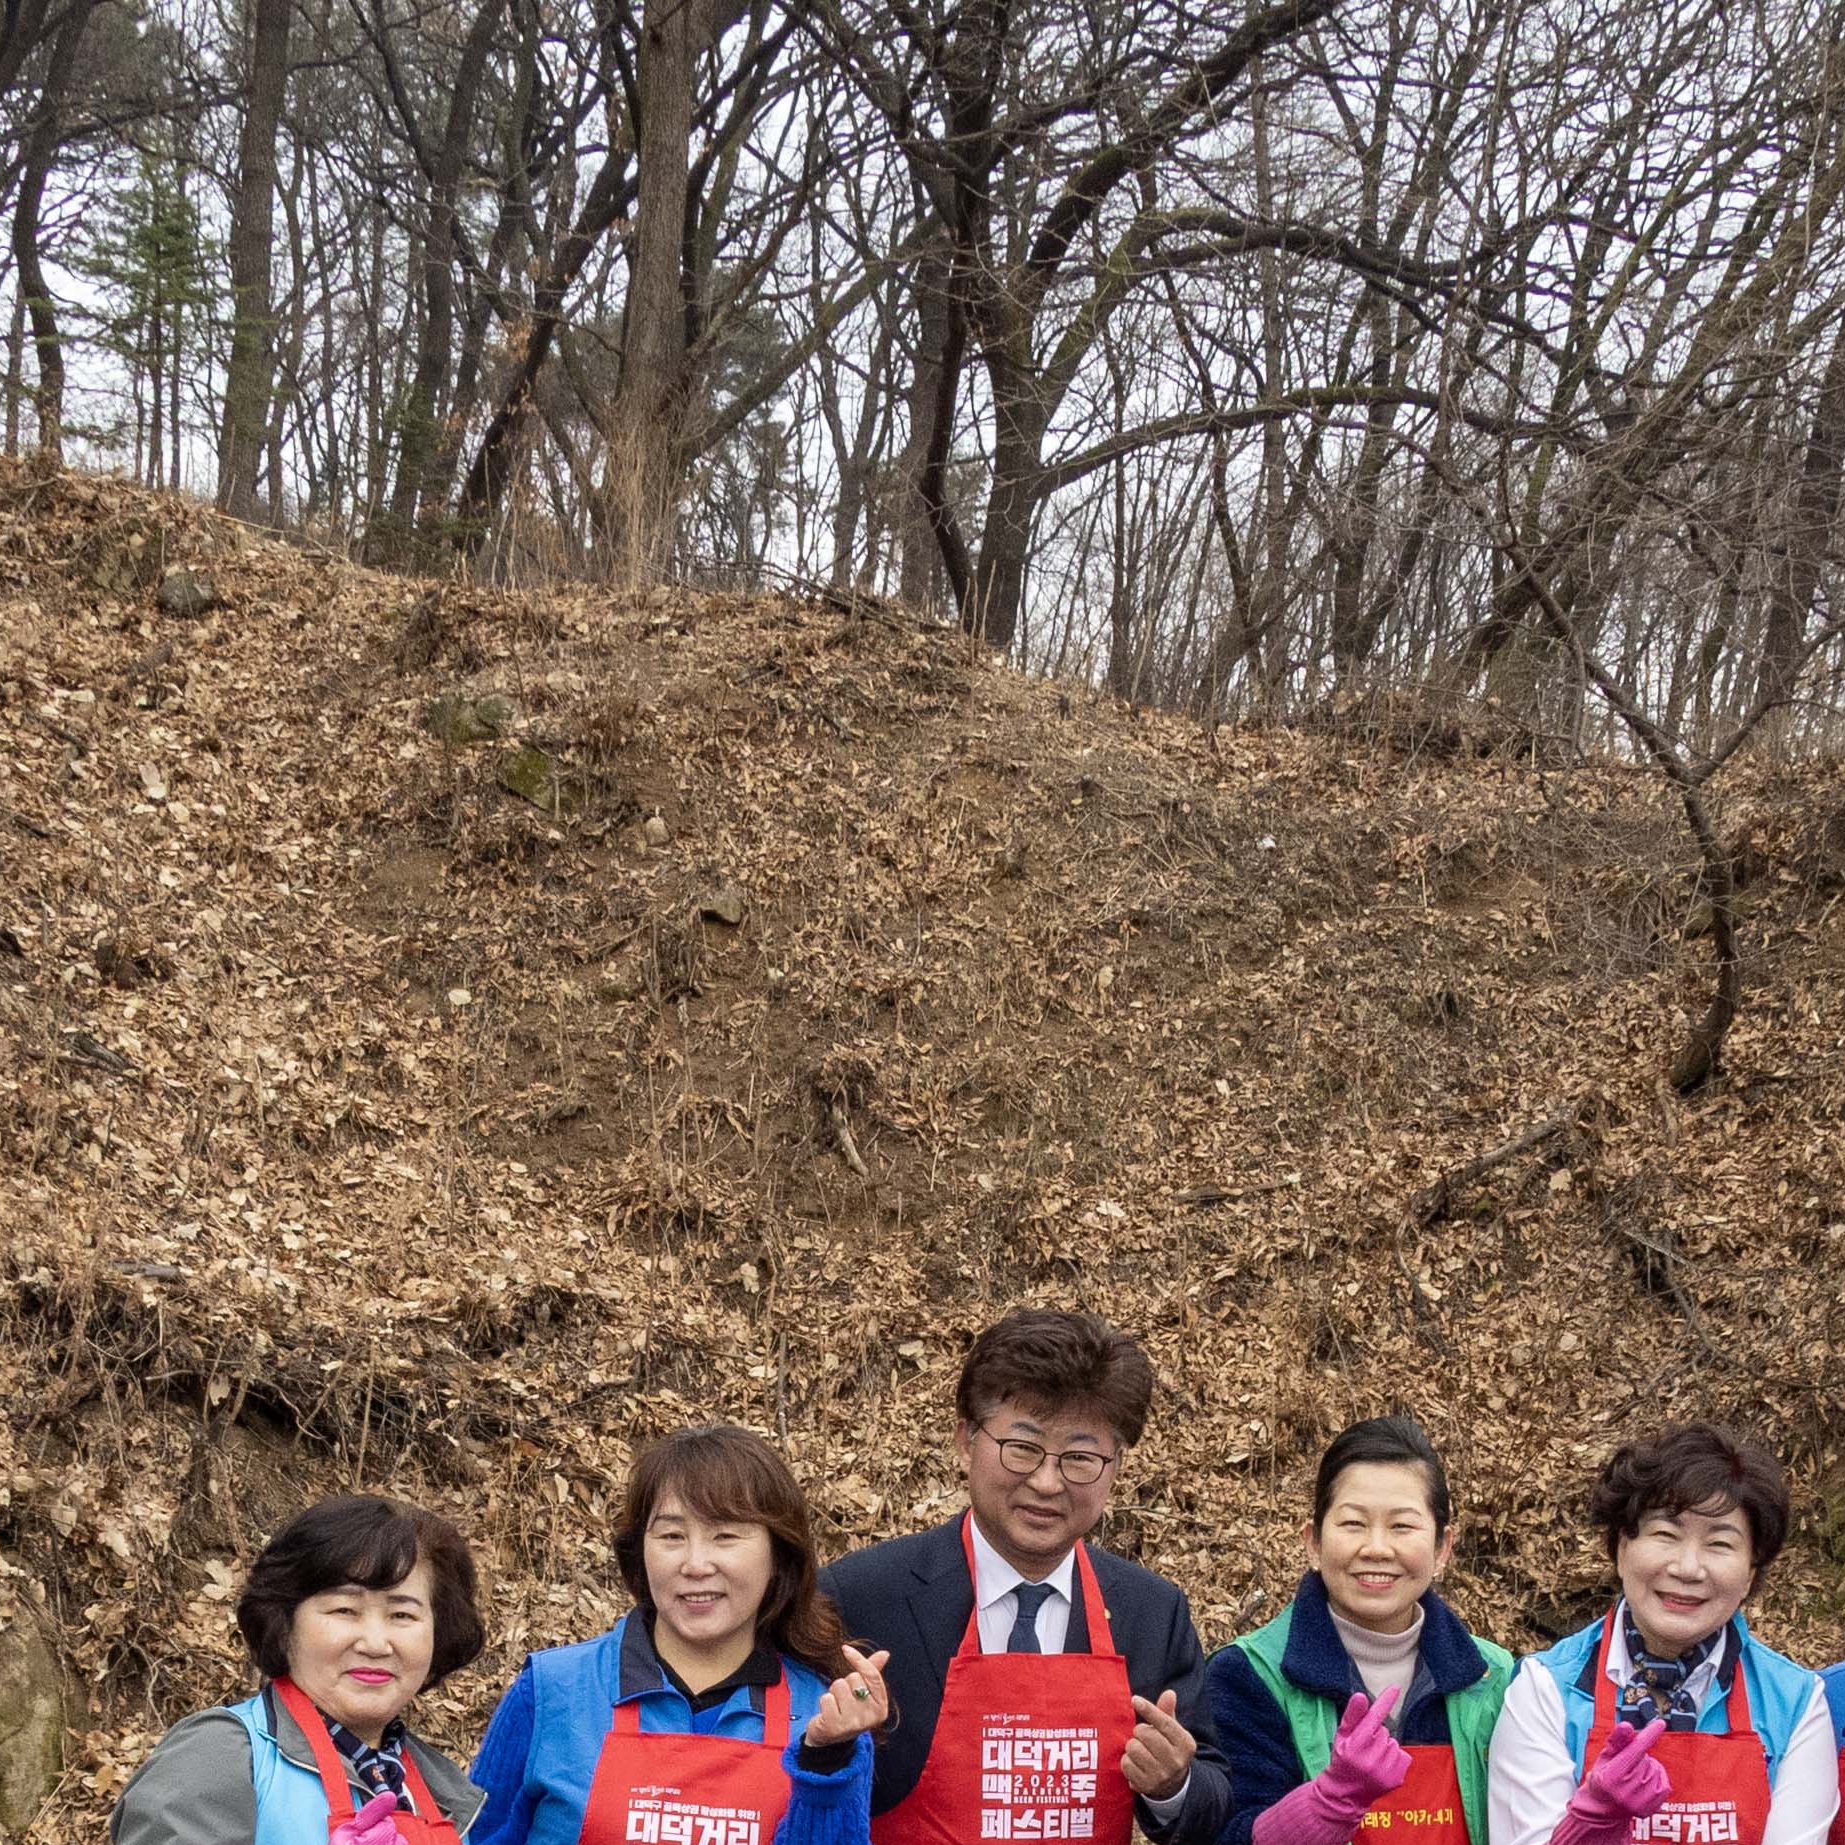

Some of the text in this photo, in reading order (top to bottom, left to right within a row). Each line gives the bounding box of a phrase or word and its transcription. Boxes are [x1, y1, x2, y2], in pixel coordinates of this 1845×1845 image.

[982, 1740, 1098, 1771] 대덕거리
[1014, 1775, 1069, 1788] 2023
[981, 1808, 1094, 1839] 페스티벌
